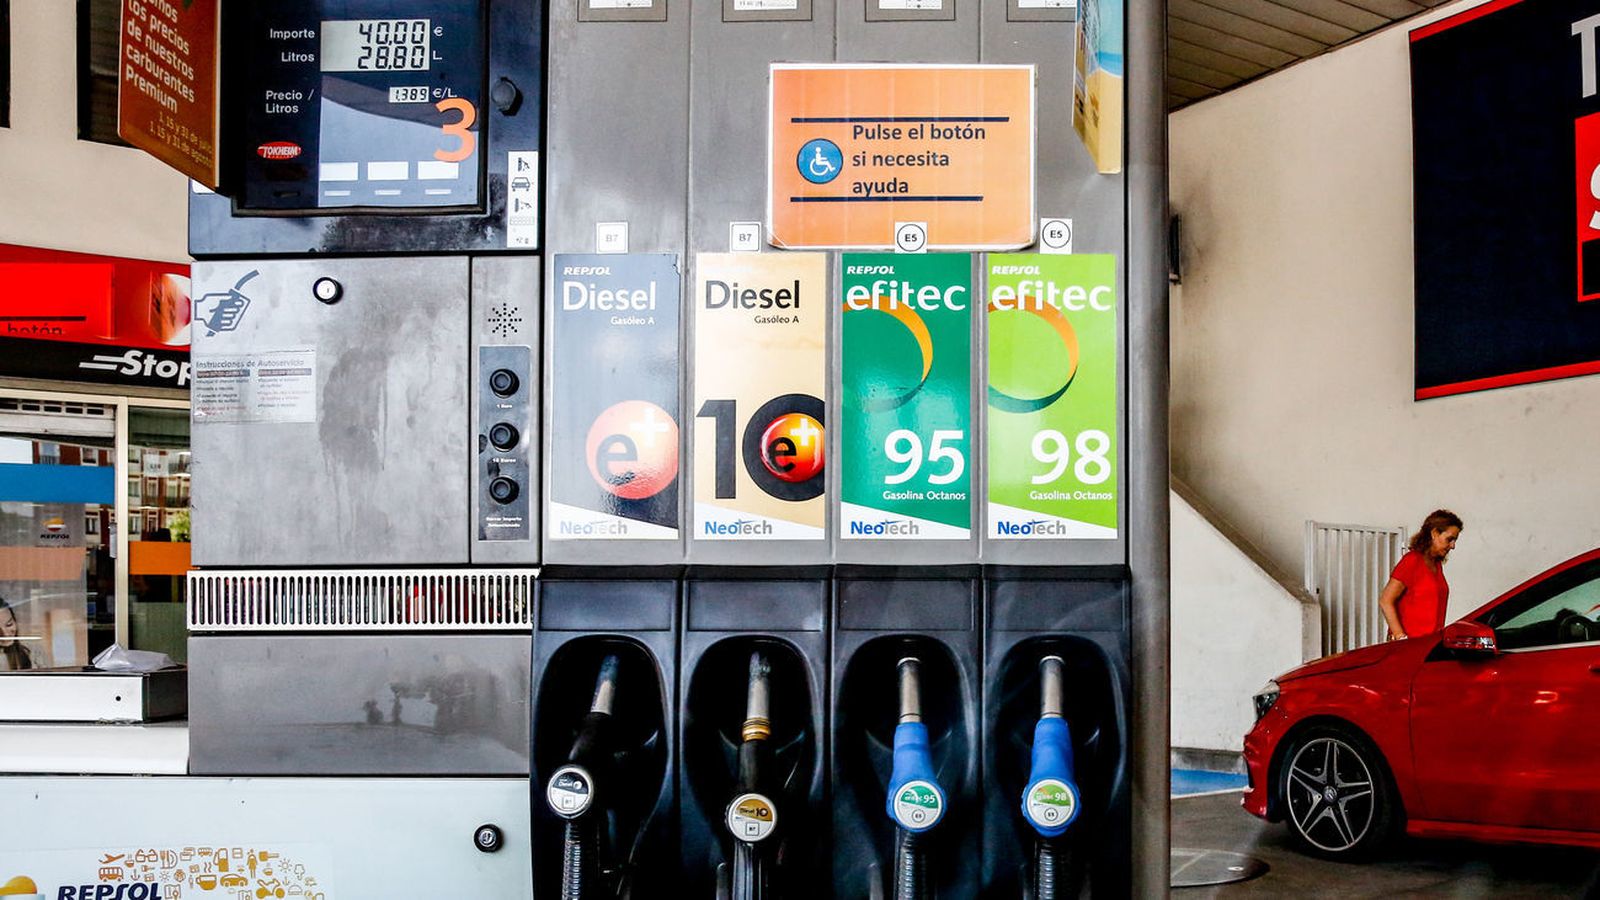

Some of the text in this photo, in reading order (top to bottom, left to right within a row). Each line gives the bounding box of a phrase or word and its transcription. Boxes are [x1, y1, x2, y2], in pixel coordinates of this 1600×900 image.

[128, 0, 190, 55] los precios
[269, 21, 444, 46] Importe 40,00 €
[128, 18, 194, 81] de nuestros
[281, 51, 315, 62] Litros
[357, 45, 426, 70] 28,80
[1571, 13, 1600, 98] T
[126, 44, 195, 103] carburantes
[126, 63, 178, 114] Premium
[265, 90, 303, 101] Precio
[265, 103, 299, 114] Litros
[433, 97, 476, 163] 3
[852, 123, 986, 141] Pulse el botón
[852, 151, 950, 167] si necesita
[852, 177, 910, 198] ayuda
[739, 233, 752, 242] B7
[904, 234, 918, 242] E5
[1050, 230, 1063, 239] E5
[563, 266, 611, 275] REPSOL
[846, 265, 895, 275] REPSOL
[992, 265, 1040, 275] REPSOL
[562, 280, 657, 311] Diesel
[705, 280, 800, 310] Diesel
[846, 279, 966, 312] efitec
[991, 279, 1112, 312] efitec
[610, 315, 655, 325] Gasóleo A
[754, 315, 800, 325] Gasóleo A
[195, 359, 305, 369] Instrucciones de Autoservicio
[696, 393, 825, 502] 10
[884, 429, 965, 485] 95
[1031, 429, 1111, 485] 98
[882, 490, 966, 501] Gasolina Octanos
[1030, 490, 1113, 501] Gasolina Octanos
[560, 519, 628, 535] NeoTech
[705, 519, 773, 535] NeoTech
[850, 519, 918, 535] NeoTech
[997, 519, 1065, 535] NeoTech
[923, 794, 936, 804] 95
[1055, 791, 1068, 801] 98
[755, 807, 769, 817] 10
[57, 882, 163, 900] REPSOL
